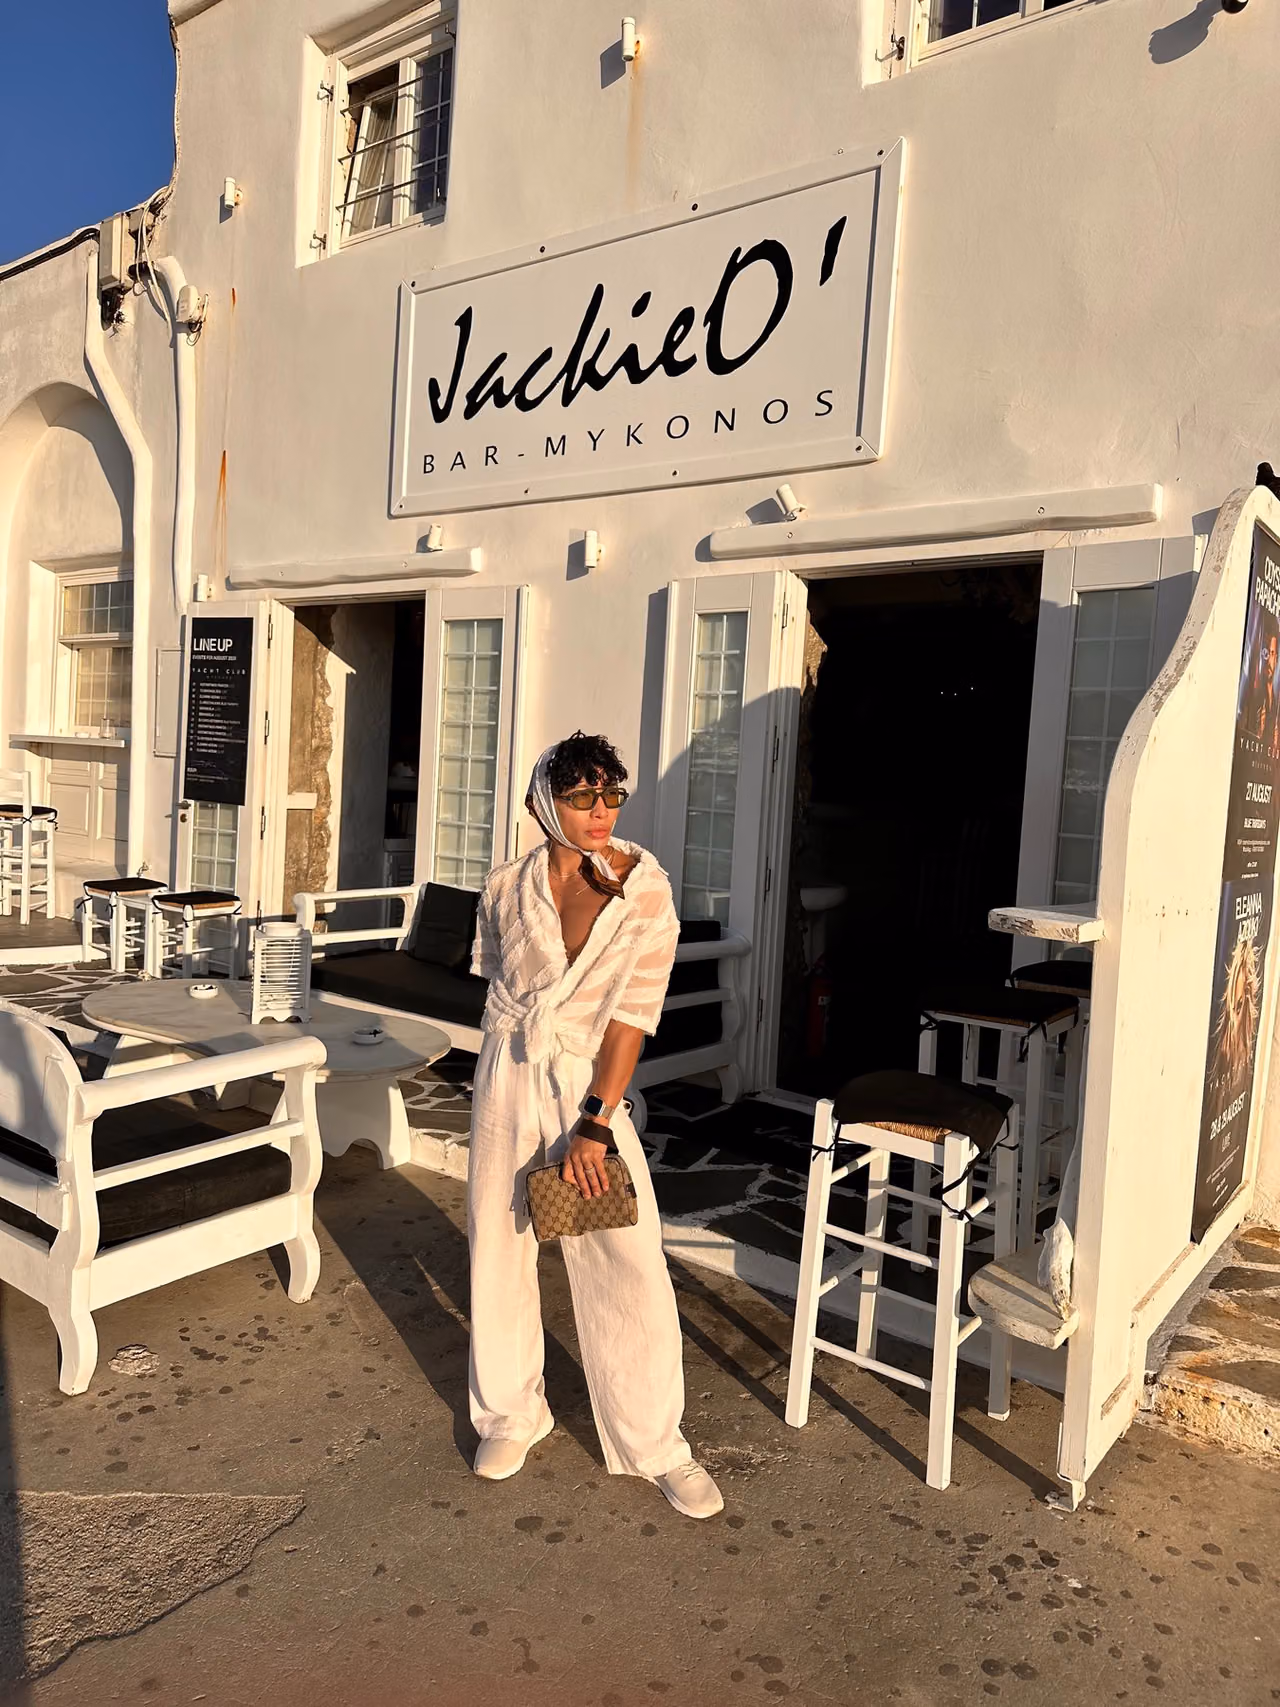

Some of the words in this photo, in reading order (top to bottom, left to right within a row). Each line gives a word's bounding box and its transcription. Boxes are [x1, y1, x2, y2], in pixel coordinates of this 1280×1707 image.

[1264, 556, 1280, 592] ODYS
[193, 638, 217, 652] LINE
[217, 638, 233, 652] UP
[1240, 737, 1264, 753] YACHT
[1252, 784, 1272, 803] AUGUST
[1235, 892, 1262, 920] ELEANNA
